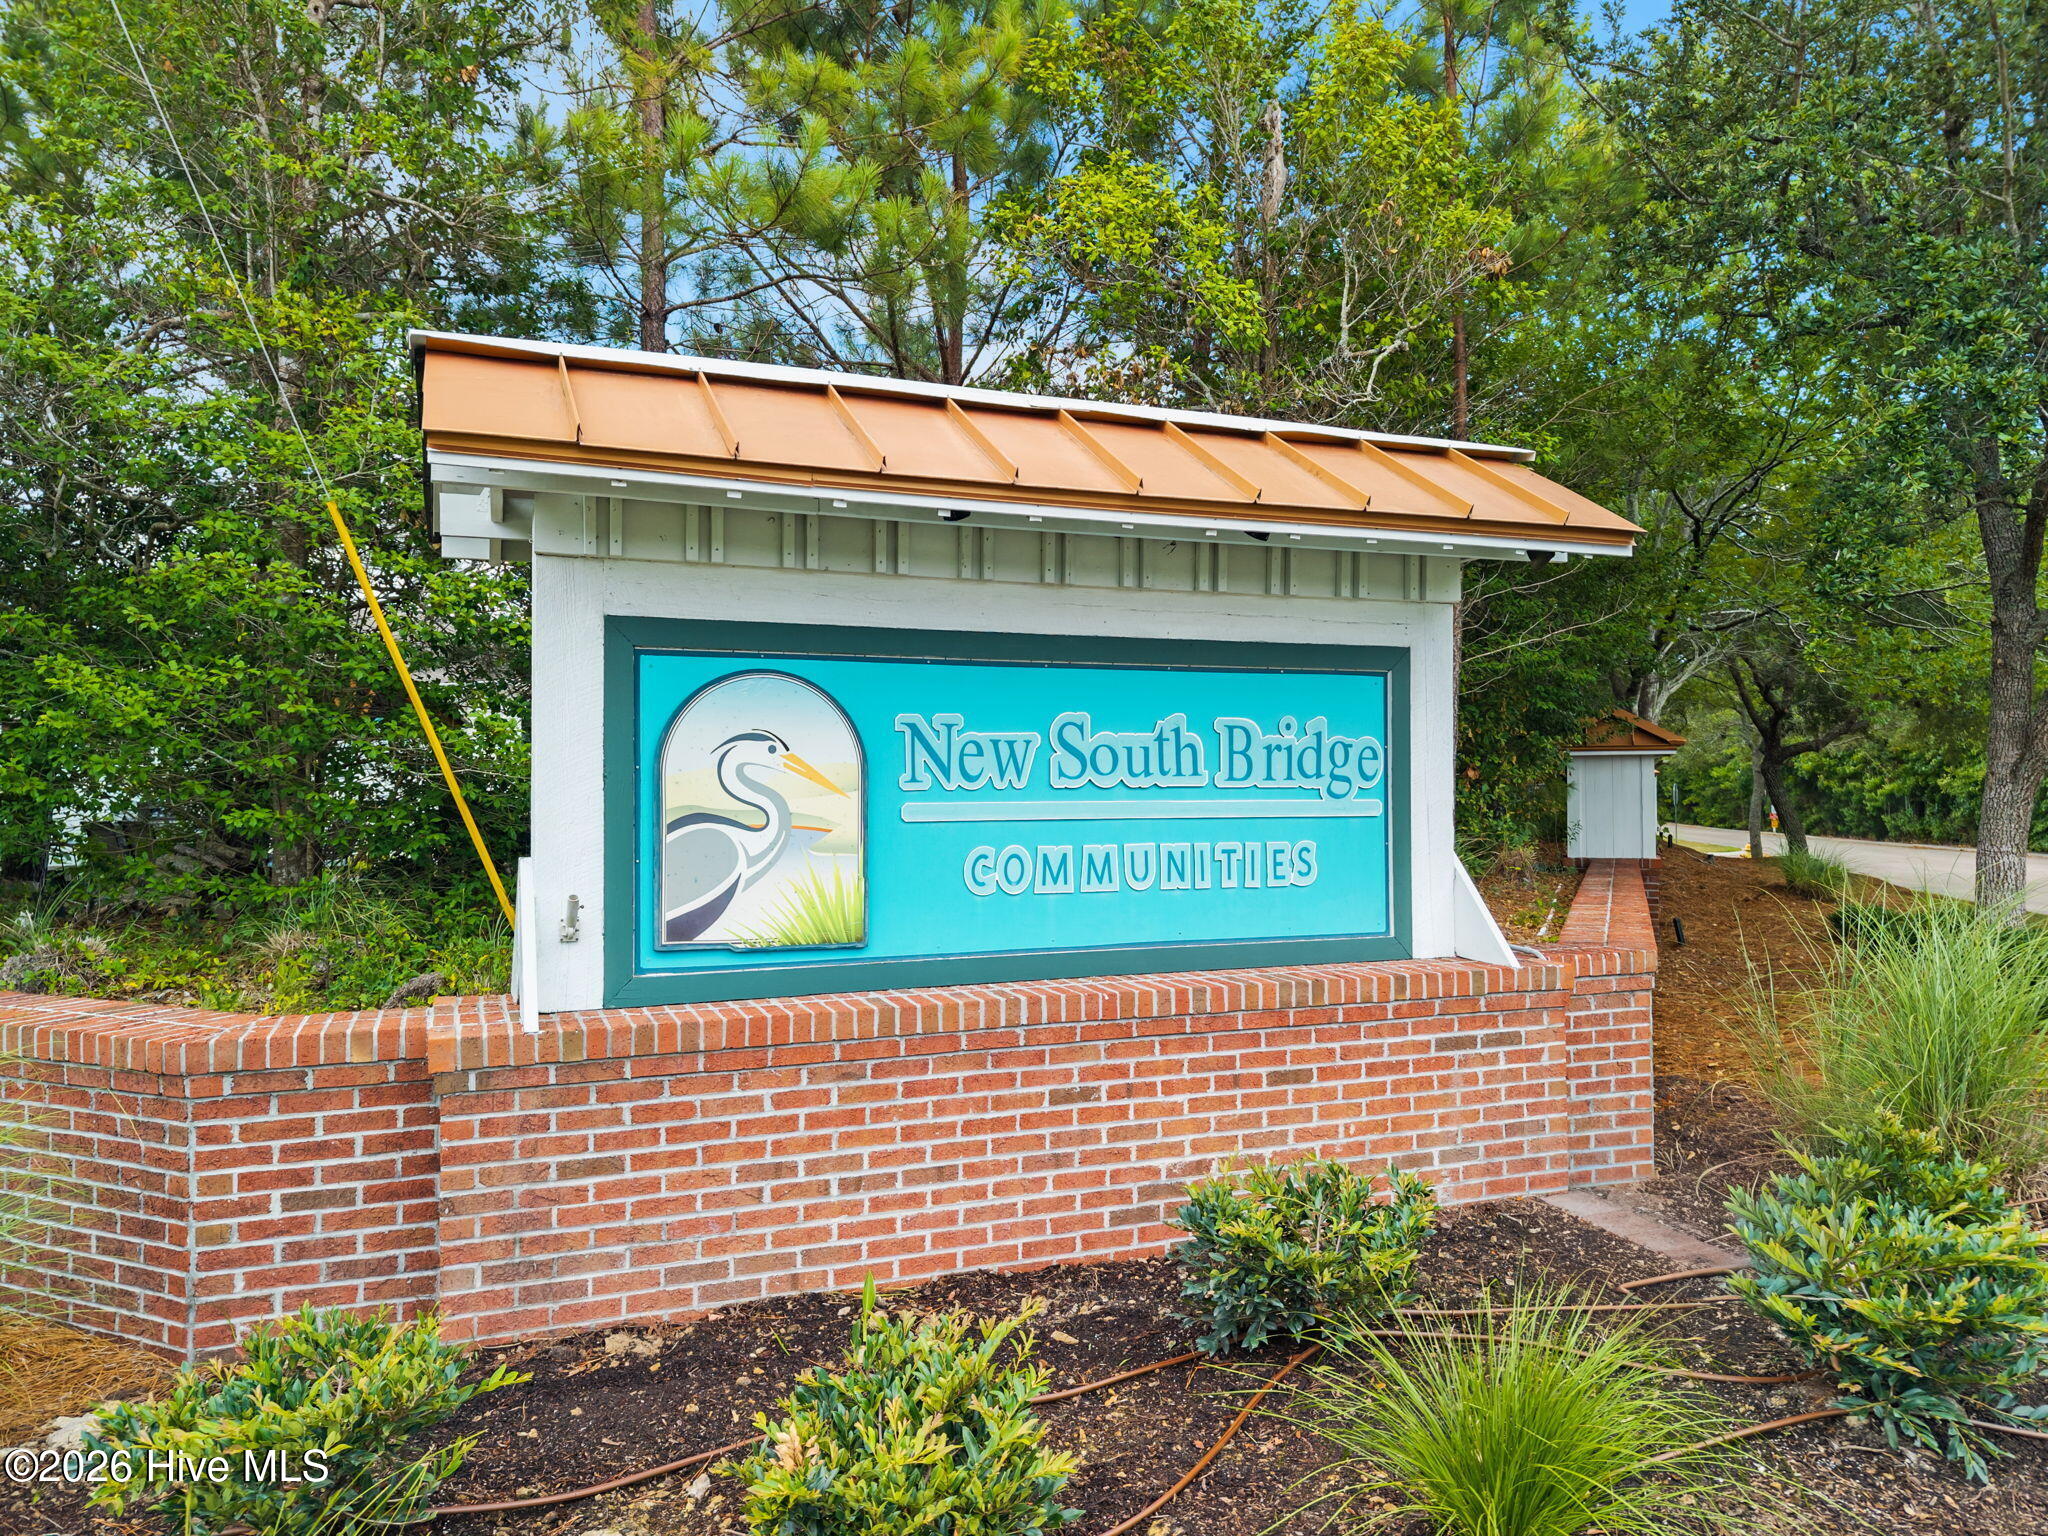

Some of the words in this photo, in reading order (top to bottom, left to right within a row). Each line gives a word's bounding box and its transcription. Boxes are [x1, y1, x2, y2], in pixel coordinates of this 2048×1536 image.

[897, 717, 1037, 788] New
[1053, 716, 1205, 786] South
[1218, 719, 1382, 800] Bridge
[966, 843, 1316, 893] COMMUNITIES
